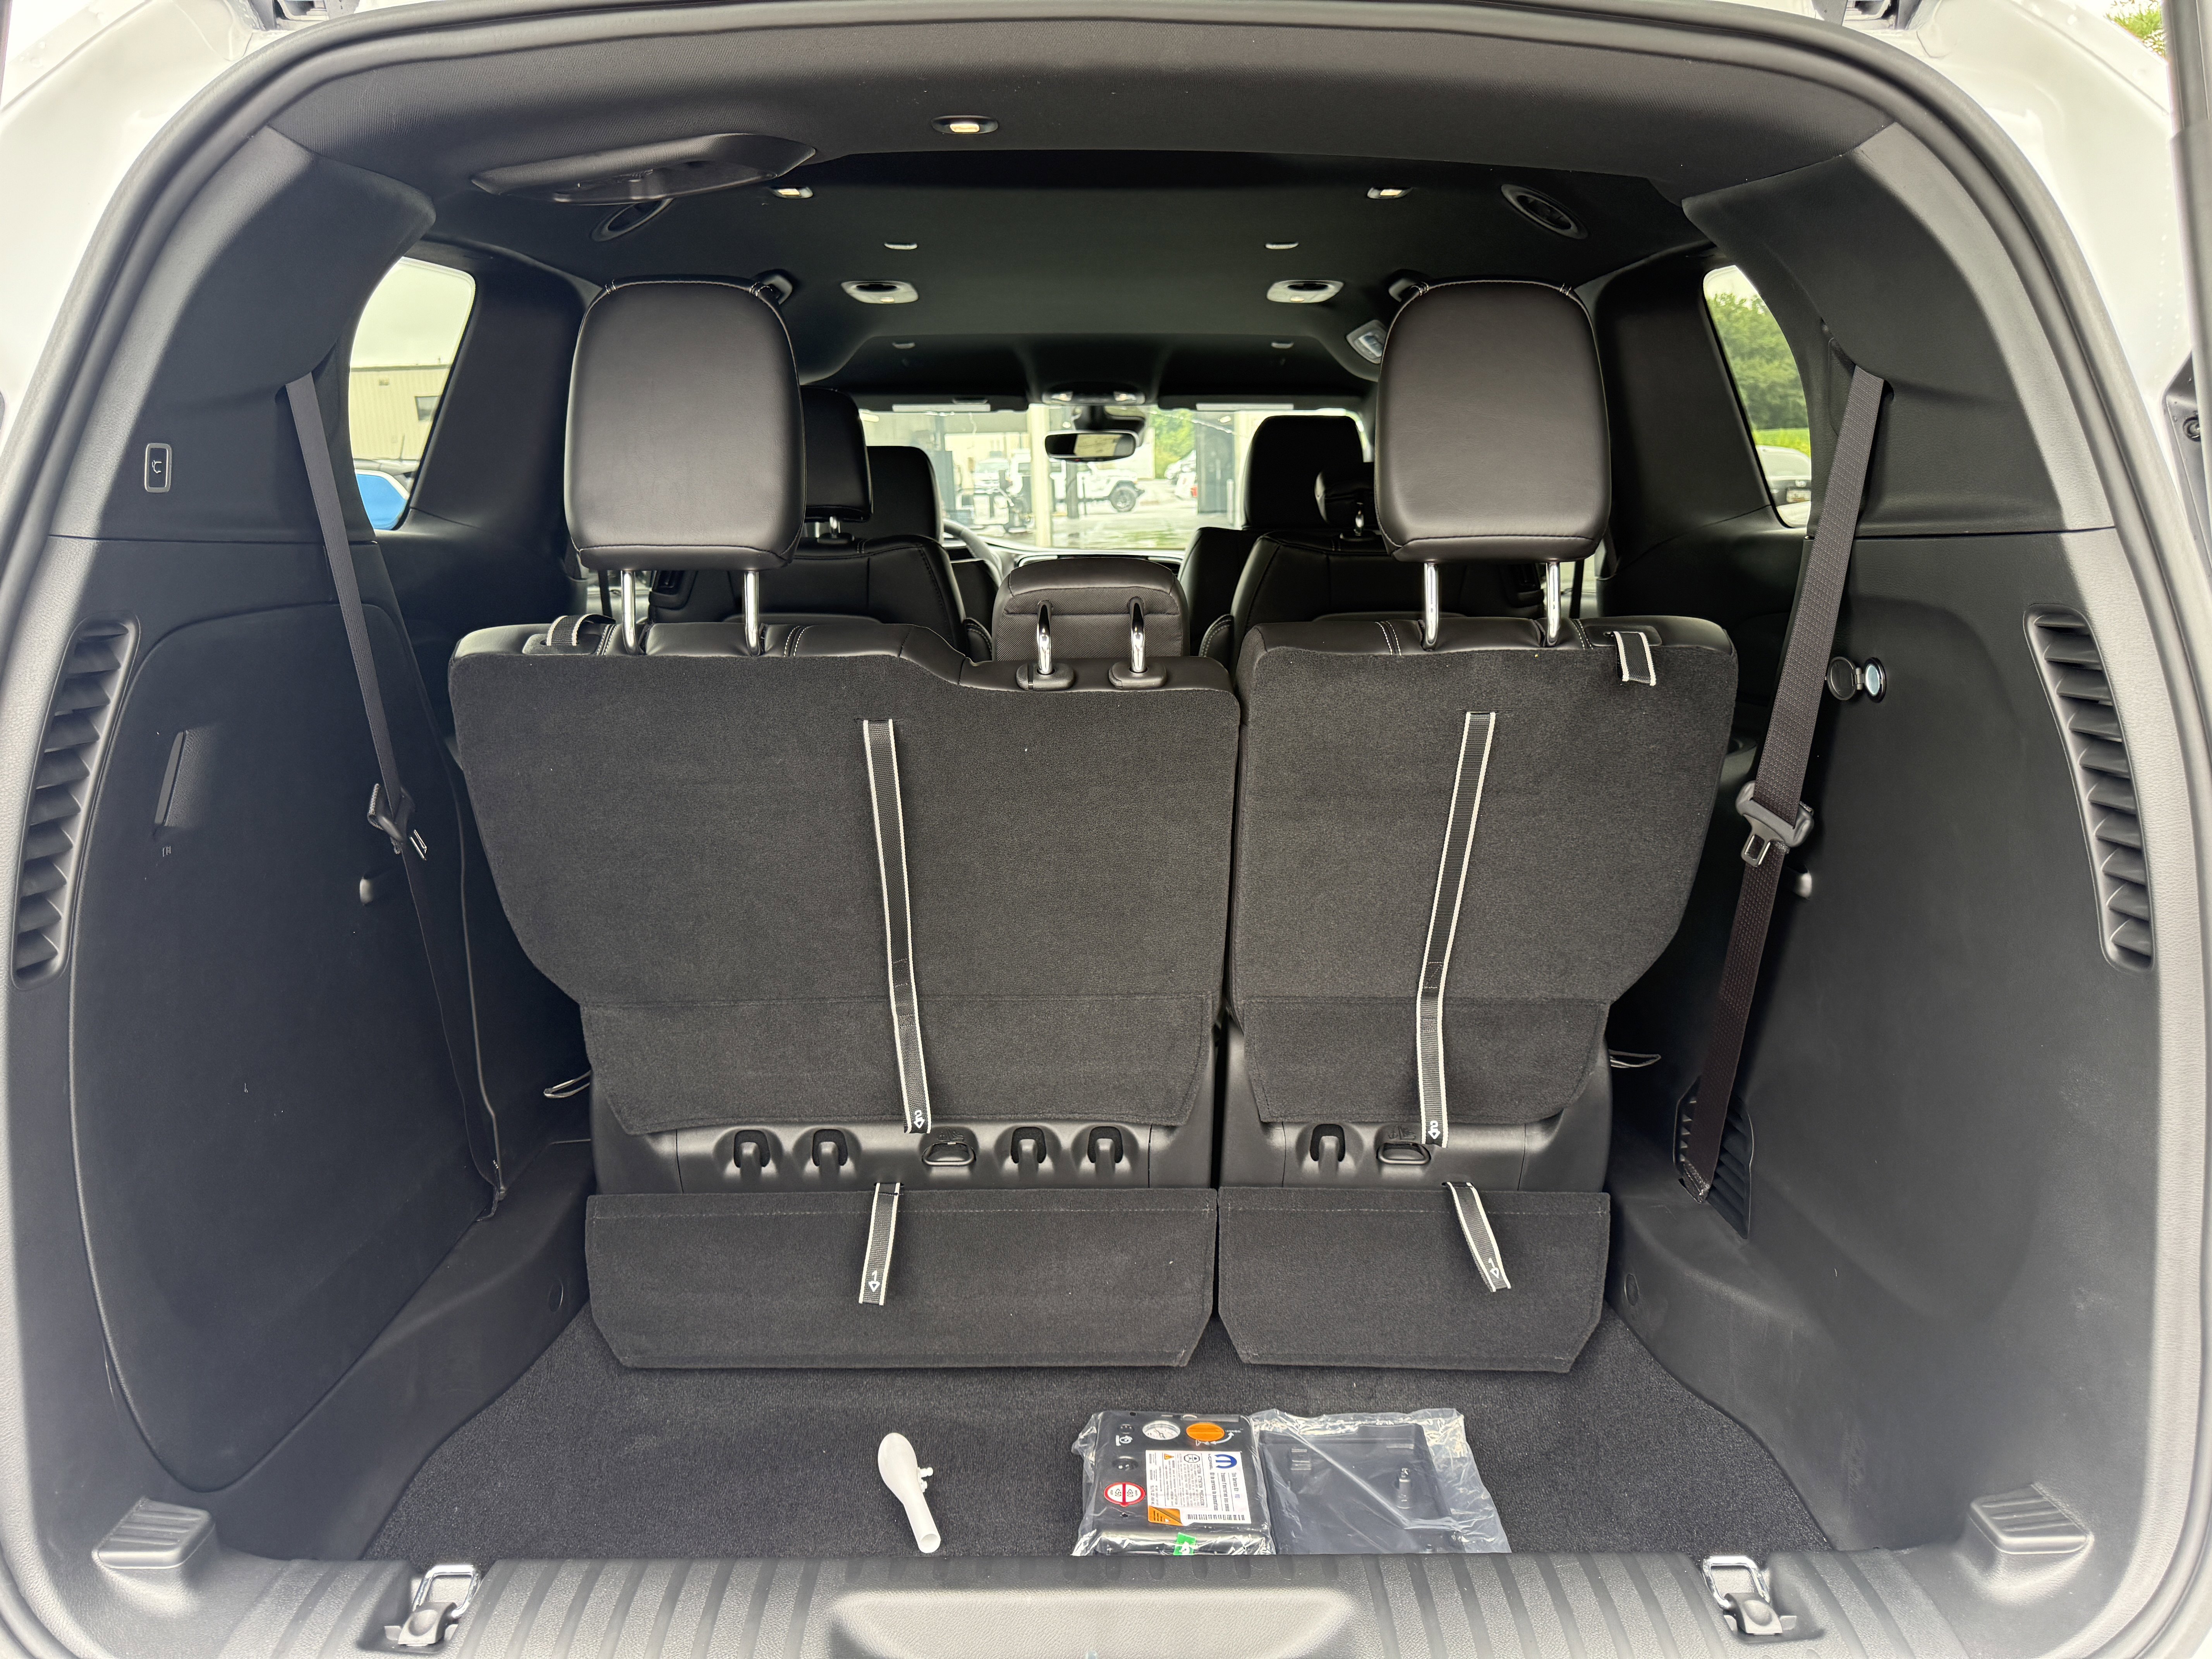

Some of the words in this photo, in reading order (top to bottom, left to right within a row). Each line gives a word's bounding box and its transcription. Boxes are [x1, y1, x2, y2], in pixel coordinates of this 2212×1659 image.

[914, 1109, 923, 1121] 2
[1430, 1120, 1438, 1130] 2
[1488, 1258, 1495, 1268] 1
[872, 1270, 877, 1281] 1
